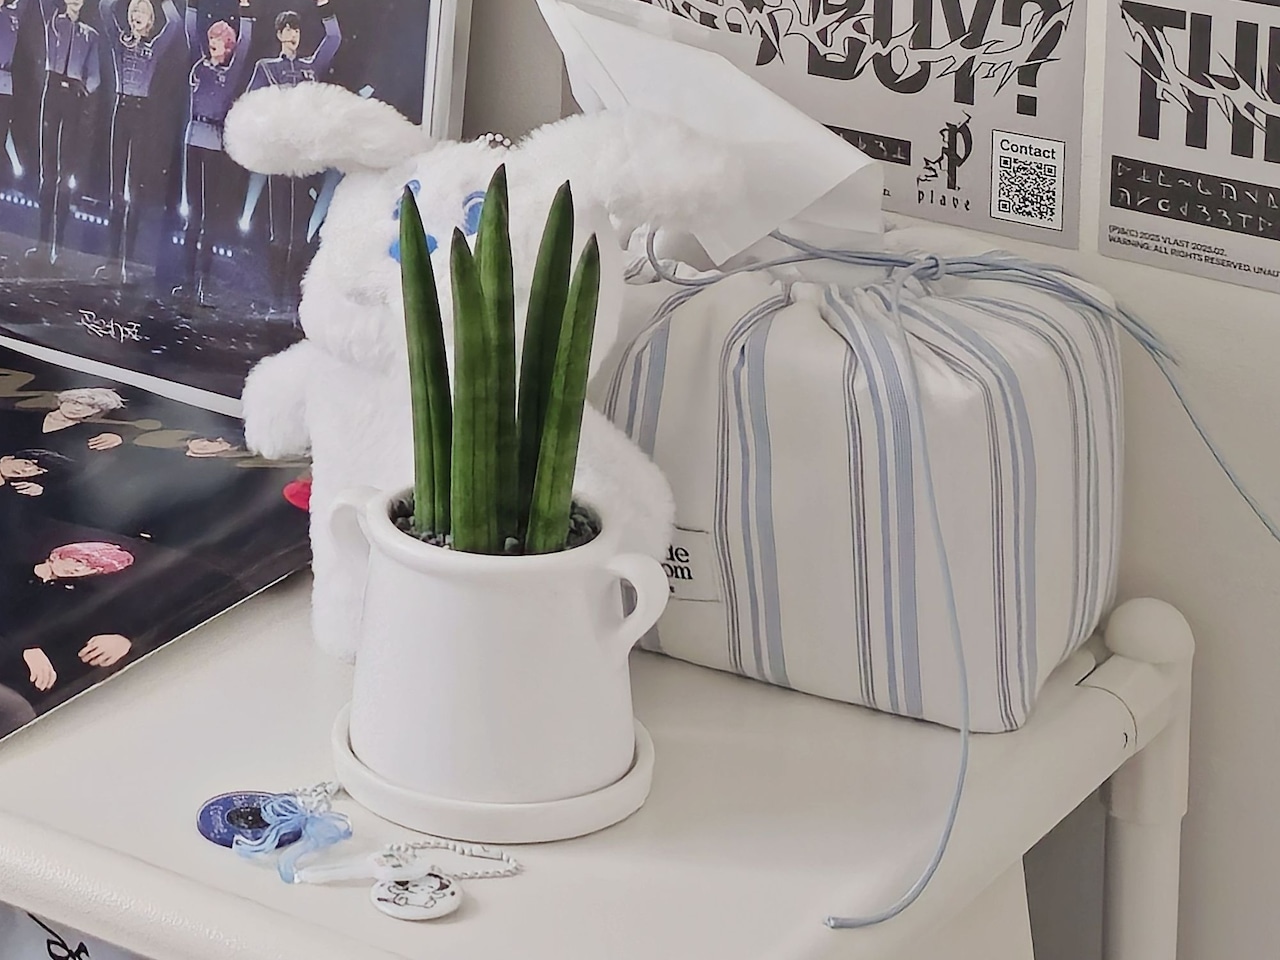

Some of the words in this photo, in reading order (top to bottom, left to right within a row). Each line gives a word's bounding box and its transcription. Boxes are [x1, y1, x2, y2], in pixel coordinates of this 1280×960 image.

[999, 137, 1057, 160] Contact
[1161, 234, 1190, 250] VLAST
[1152, 244, 1169, 256] ALL
[1169, 246, 1203, 263] RIGHTS
